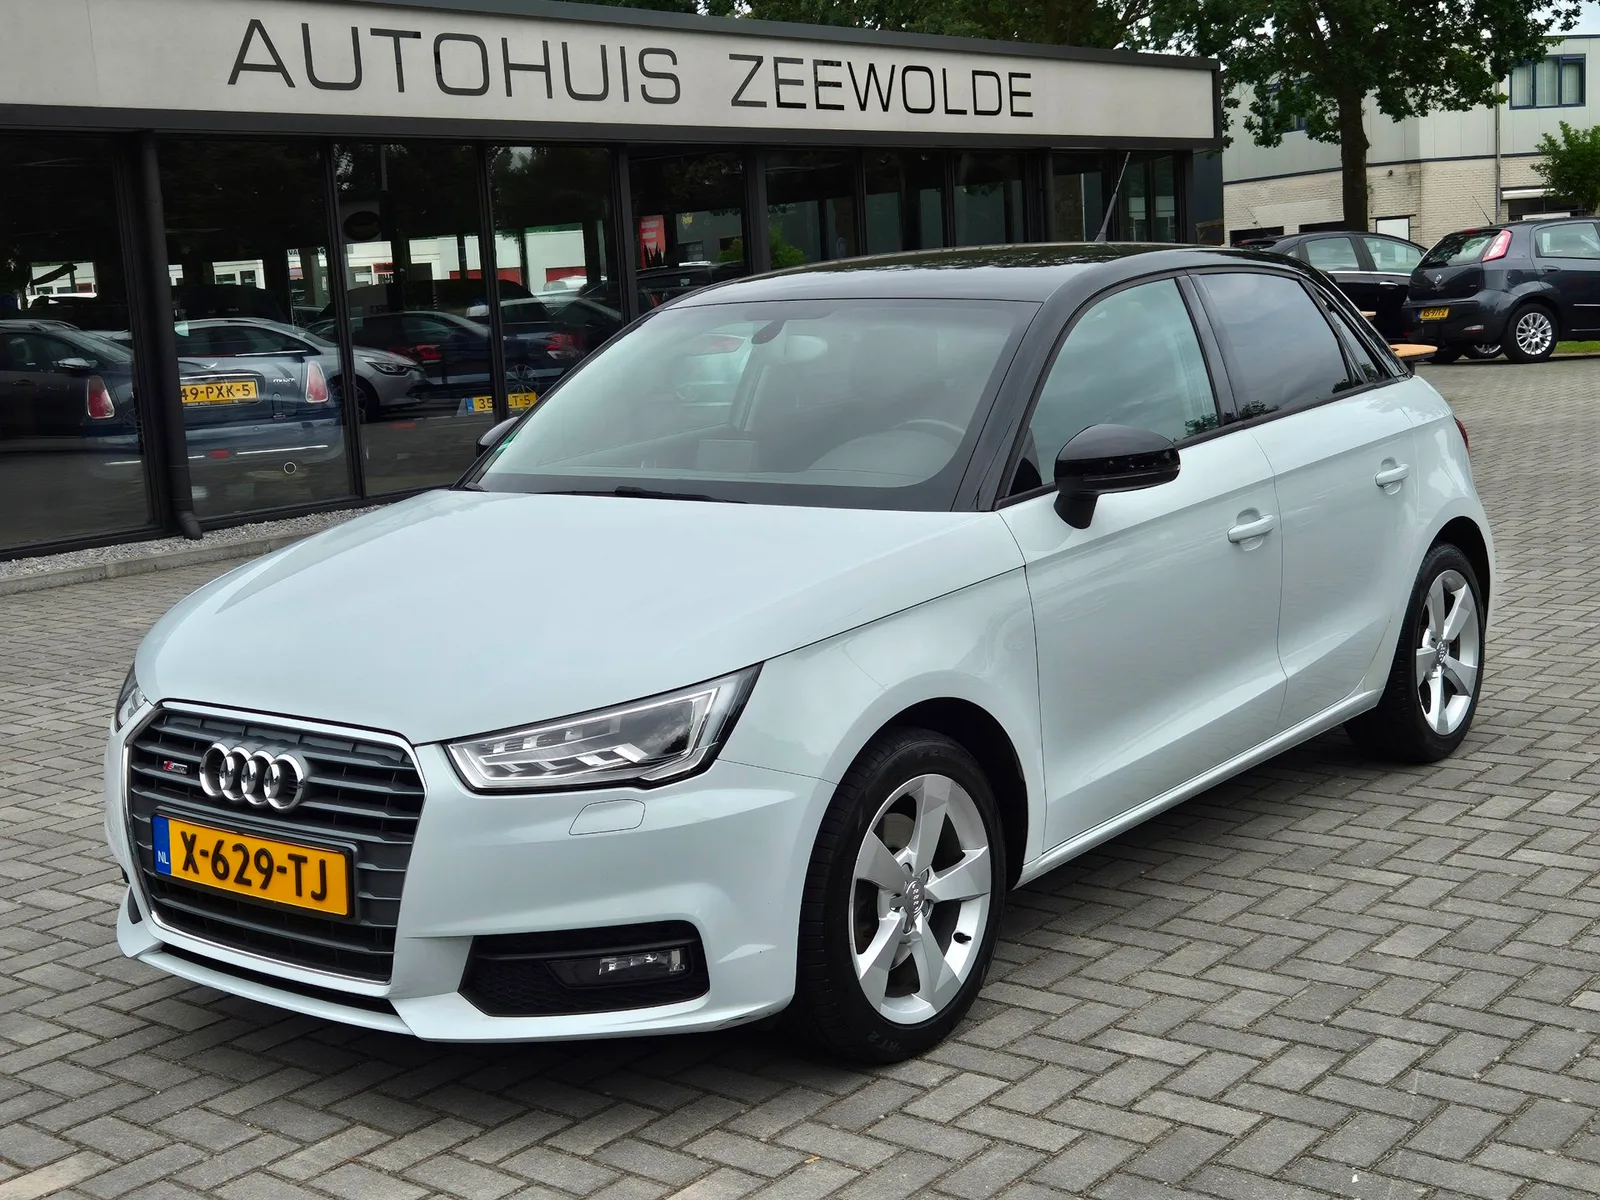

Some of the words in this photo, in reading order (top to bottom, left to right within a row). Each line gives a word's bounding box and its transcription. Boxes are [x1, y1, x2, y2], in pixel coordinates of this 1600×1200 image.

[227, 18, 681, 104] AUTOHUIS
[728, 53, 1034, 117] ZEEWOLDE
[180, 384, 251, 401] 49-PXK-5
[157, 850, 170, 865] NL
[180, 831, 327, 901] X-629-TJ
